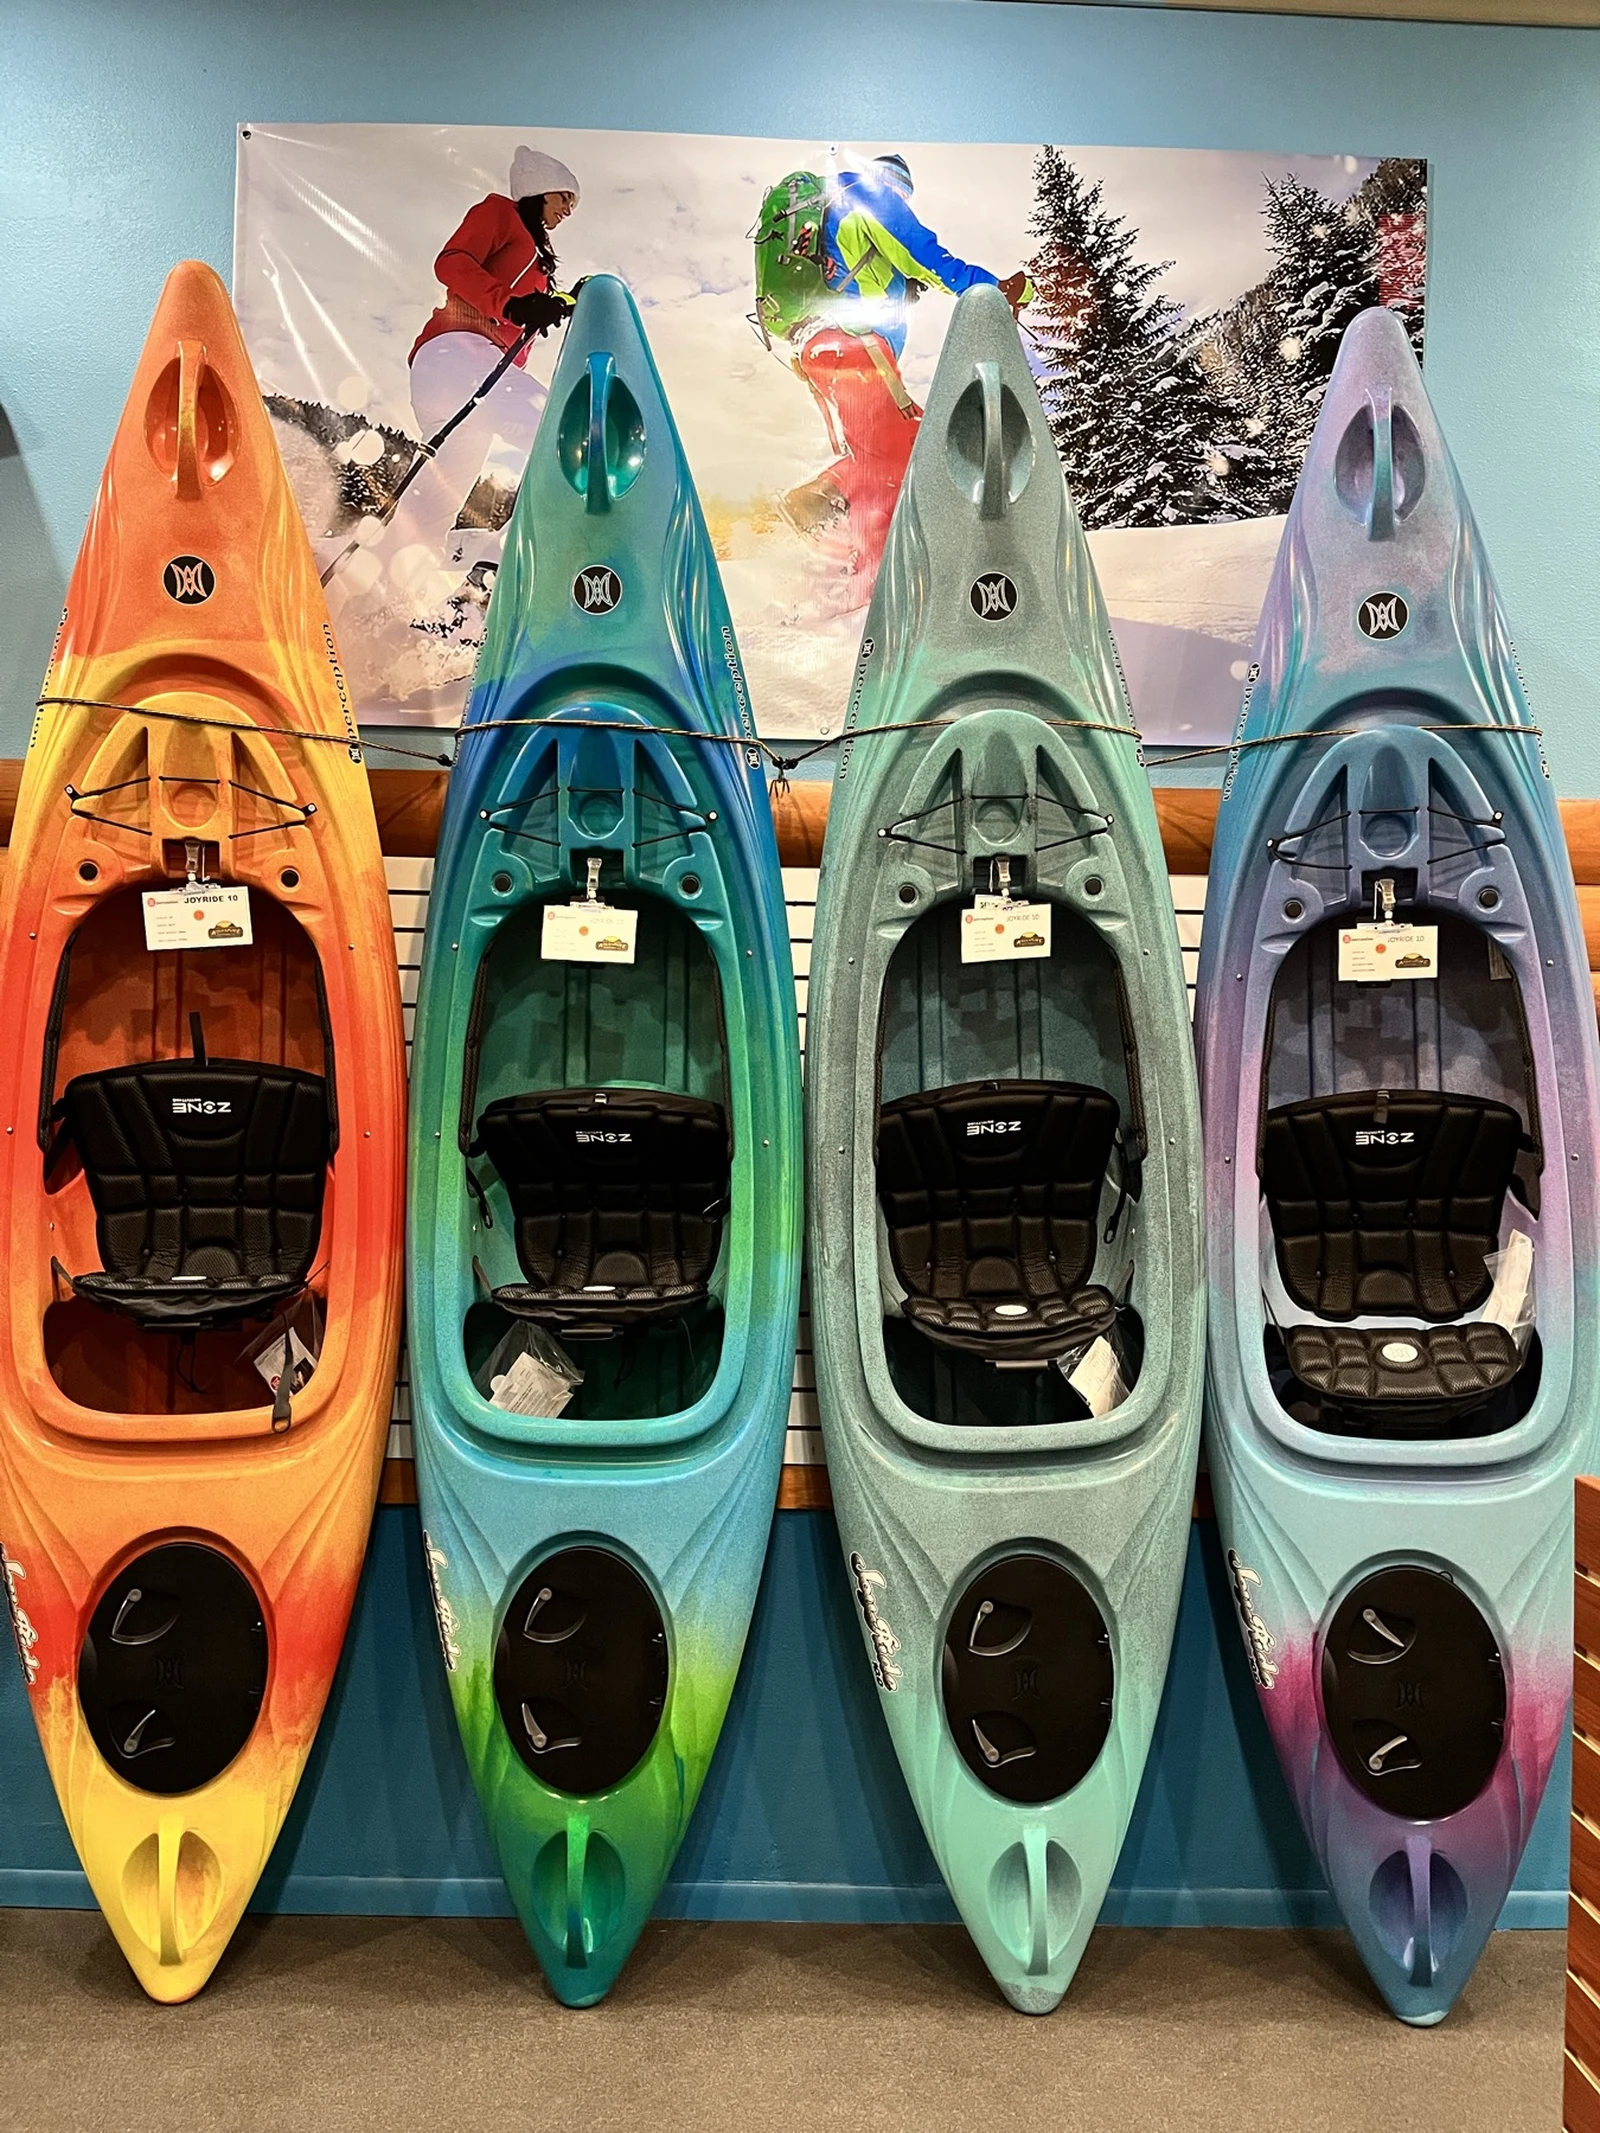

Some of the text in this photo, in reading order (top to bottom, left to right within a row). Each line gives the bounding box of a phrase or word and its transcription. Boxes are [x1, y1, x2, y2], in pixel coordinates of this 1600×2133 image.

[322, 623, 358, 740] perception
[184, 895, 224, 904] JOYRIDE
[1006, 914, 1030, 922] JOYRDE
[172, 1100, 232, 1115] ZONE
[966, 1120, 1022, 1136] ZONE
[575, 1132, 632, 1143] ZONE
[1355, 1131, 1415, 1145] ZONE
